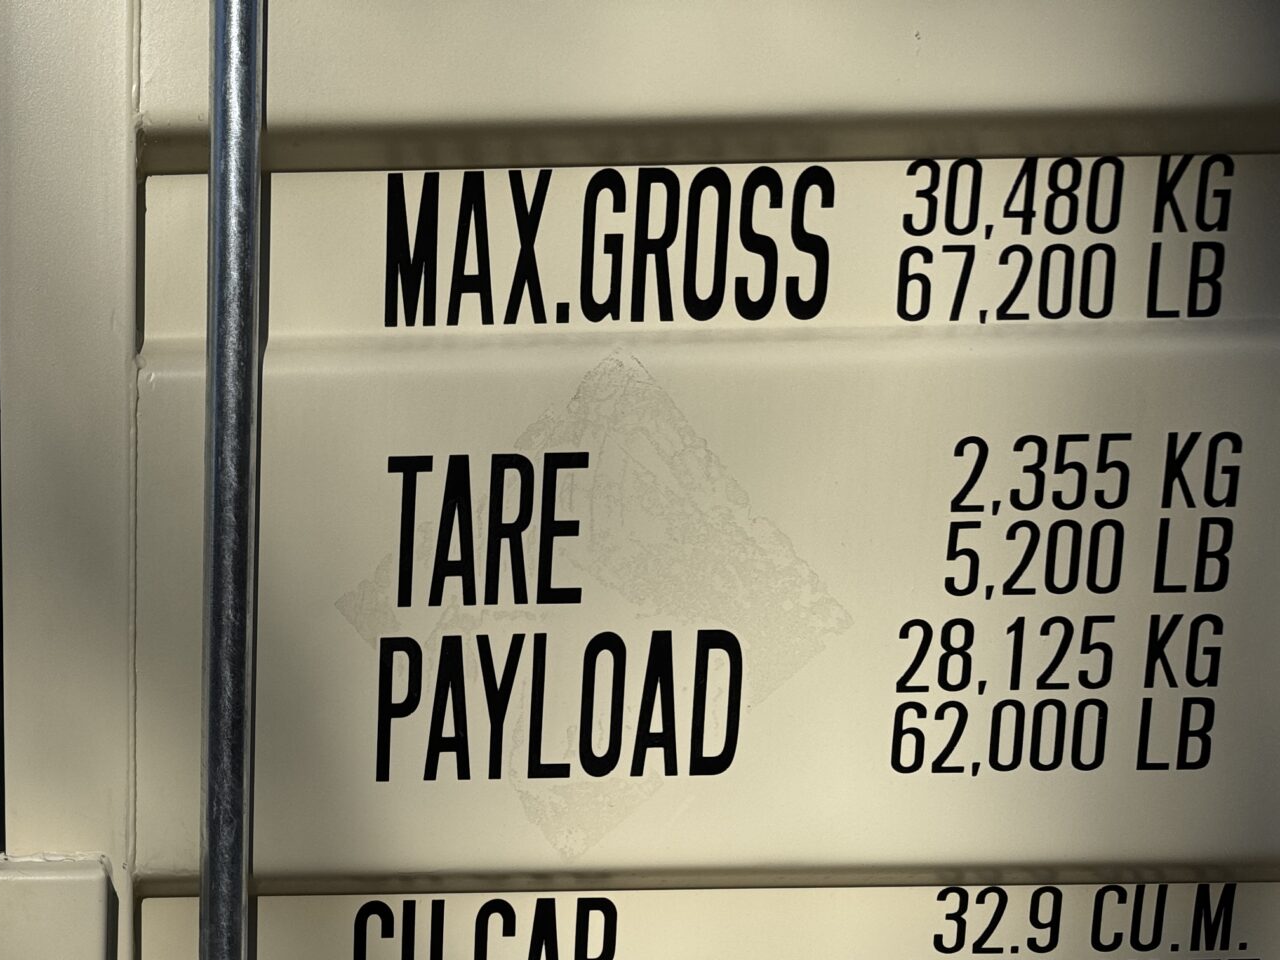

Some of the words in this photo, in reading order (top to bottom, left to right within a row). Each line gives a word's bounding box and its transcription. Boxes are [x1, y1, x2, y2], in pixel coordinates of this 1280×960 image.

[902, 157, 1124, 239] 30,480
[1152, 153, 1236, 233] KG
[384, 165, 836, 328] MAX.GROSS
[897, 243, 1116, 324] 67,200
[1147, 241, 1225, 318] LB
[951, 433, 1132, 515] 2,355
[1162, 432, 1242, 508] KG
[388, 452, 589, 607] TARE
[945, 519, 1124, 600] 5,200
[1154, 517, 1233, 593] LB
[896, 615, 1115, 695] 28,125
[1144, 614, 1223, 688] KG
[376, 630, 742, 782] PAYLOAD
[891, 698, 1108, 776] 62,000
[1137, 697, 1215, 770] LB
[932, 886, 1064, 955] 32.9
[1090, 884, 1249, 954] CU.M.
